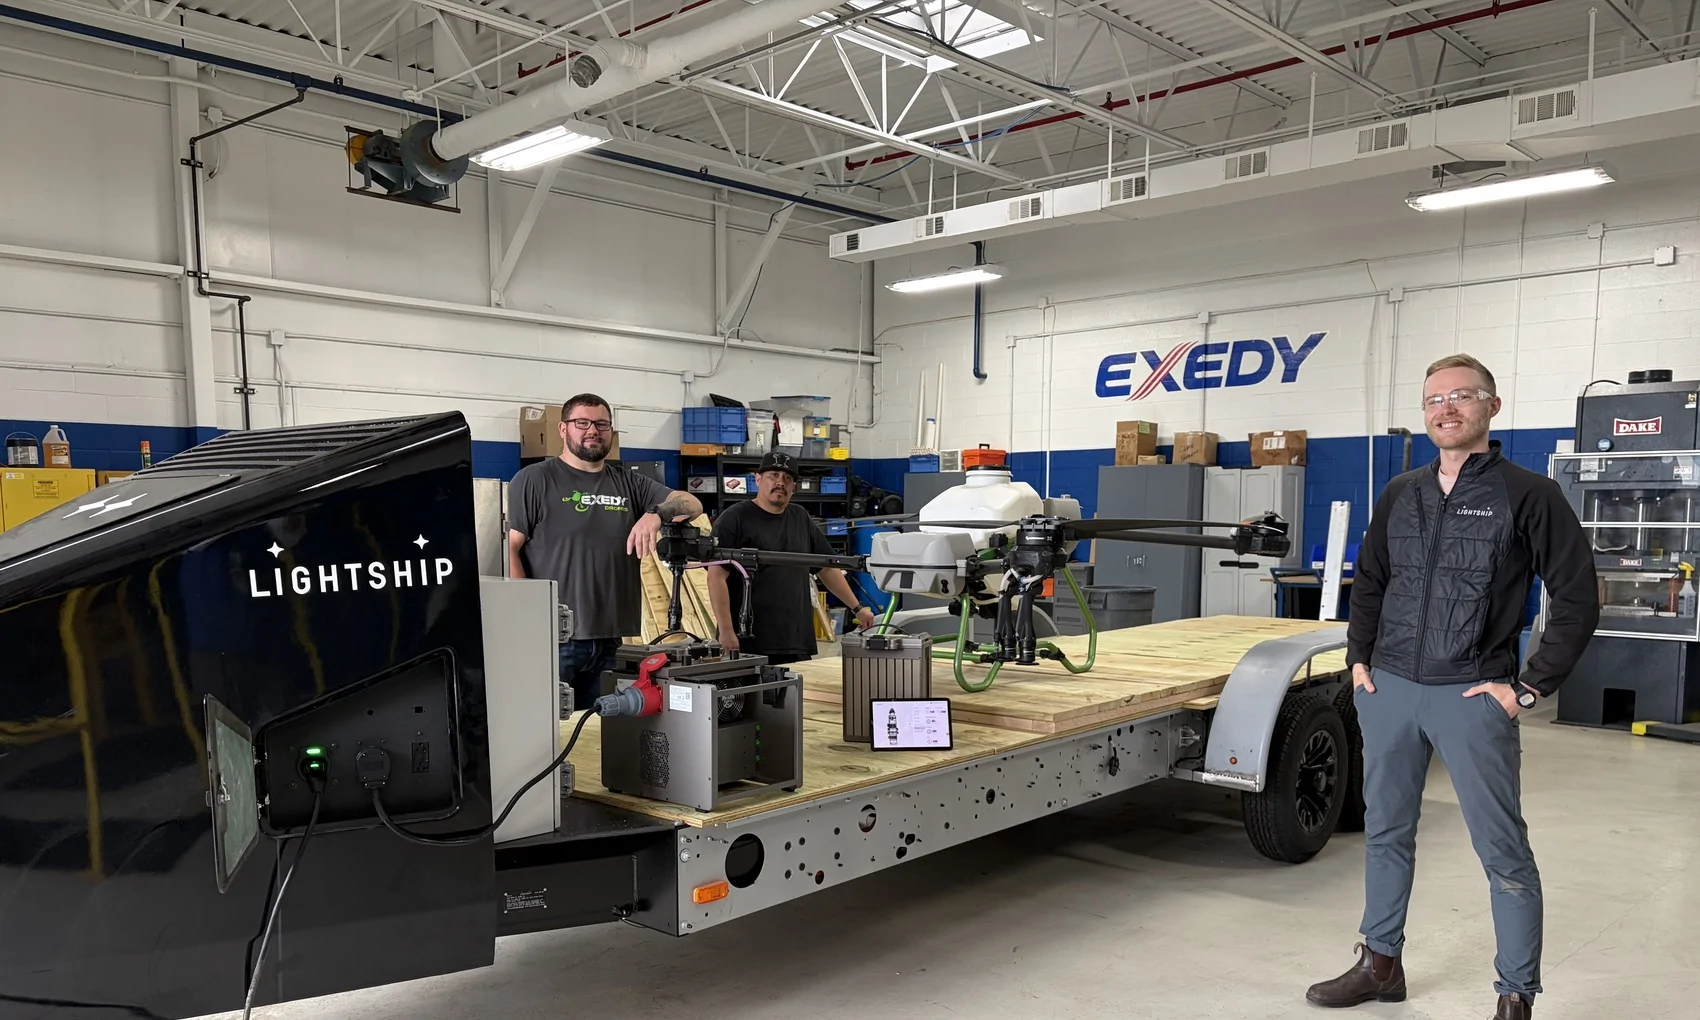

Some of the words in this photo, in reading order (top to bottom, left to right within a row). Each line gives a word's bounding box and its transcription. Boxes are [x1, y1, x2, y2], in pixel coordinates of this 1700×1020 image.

[1095, 332, 1327, 401] EXEDY
[1619, 422, 1657, 433] DAKE
[581, 495, 628, 505] EXEDY
[1456, 508, 1493, 516] LIGHTSHIP
[249, 557, 453, 597] LIGHTSHIP
